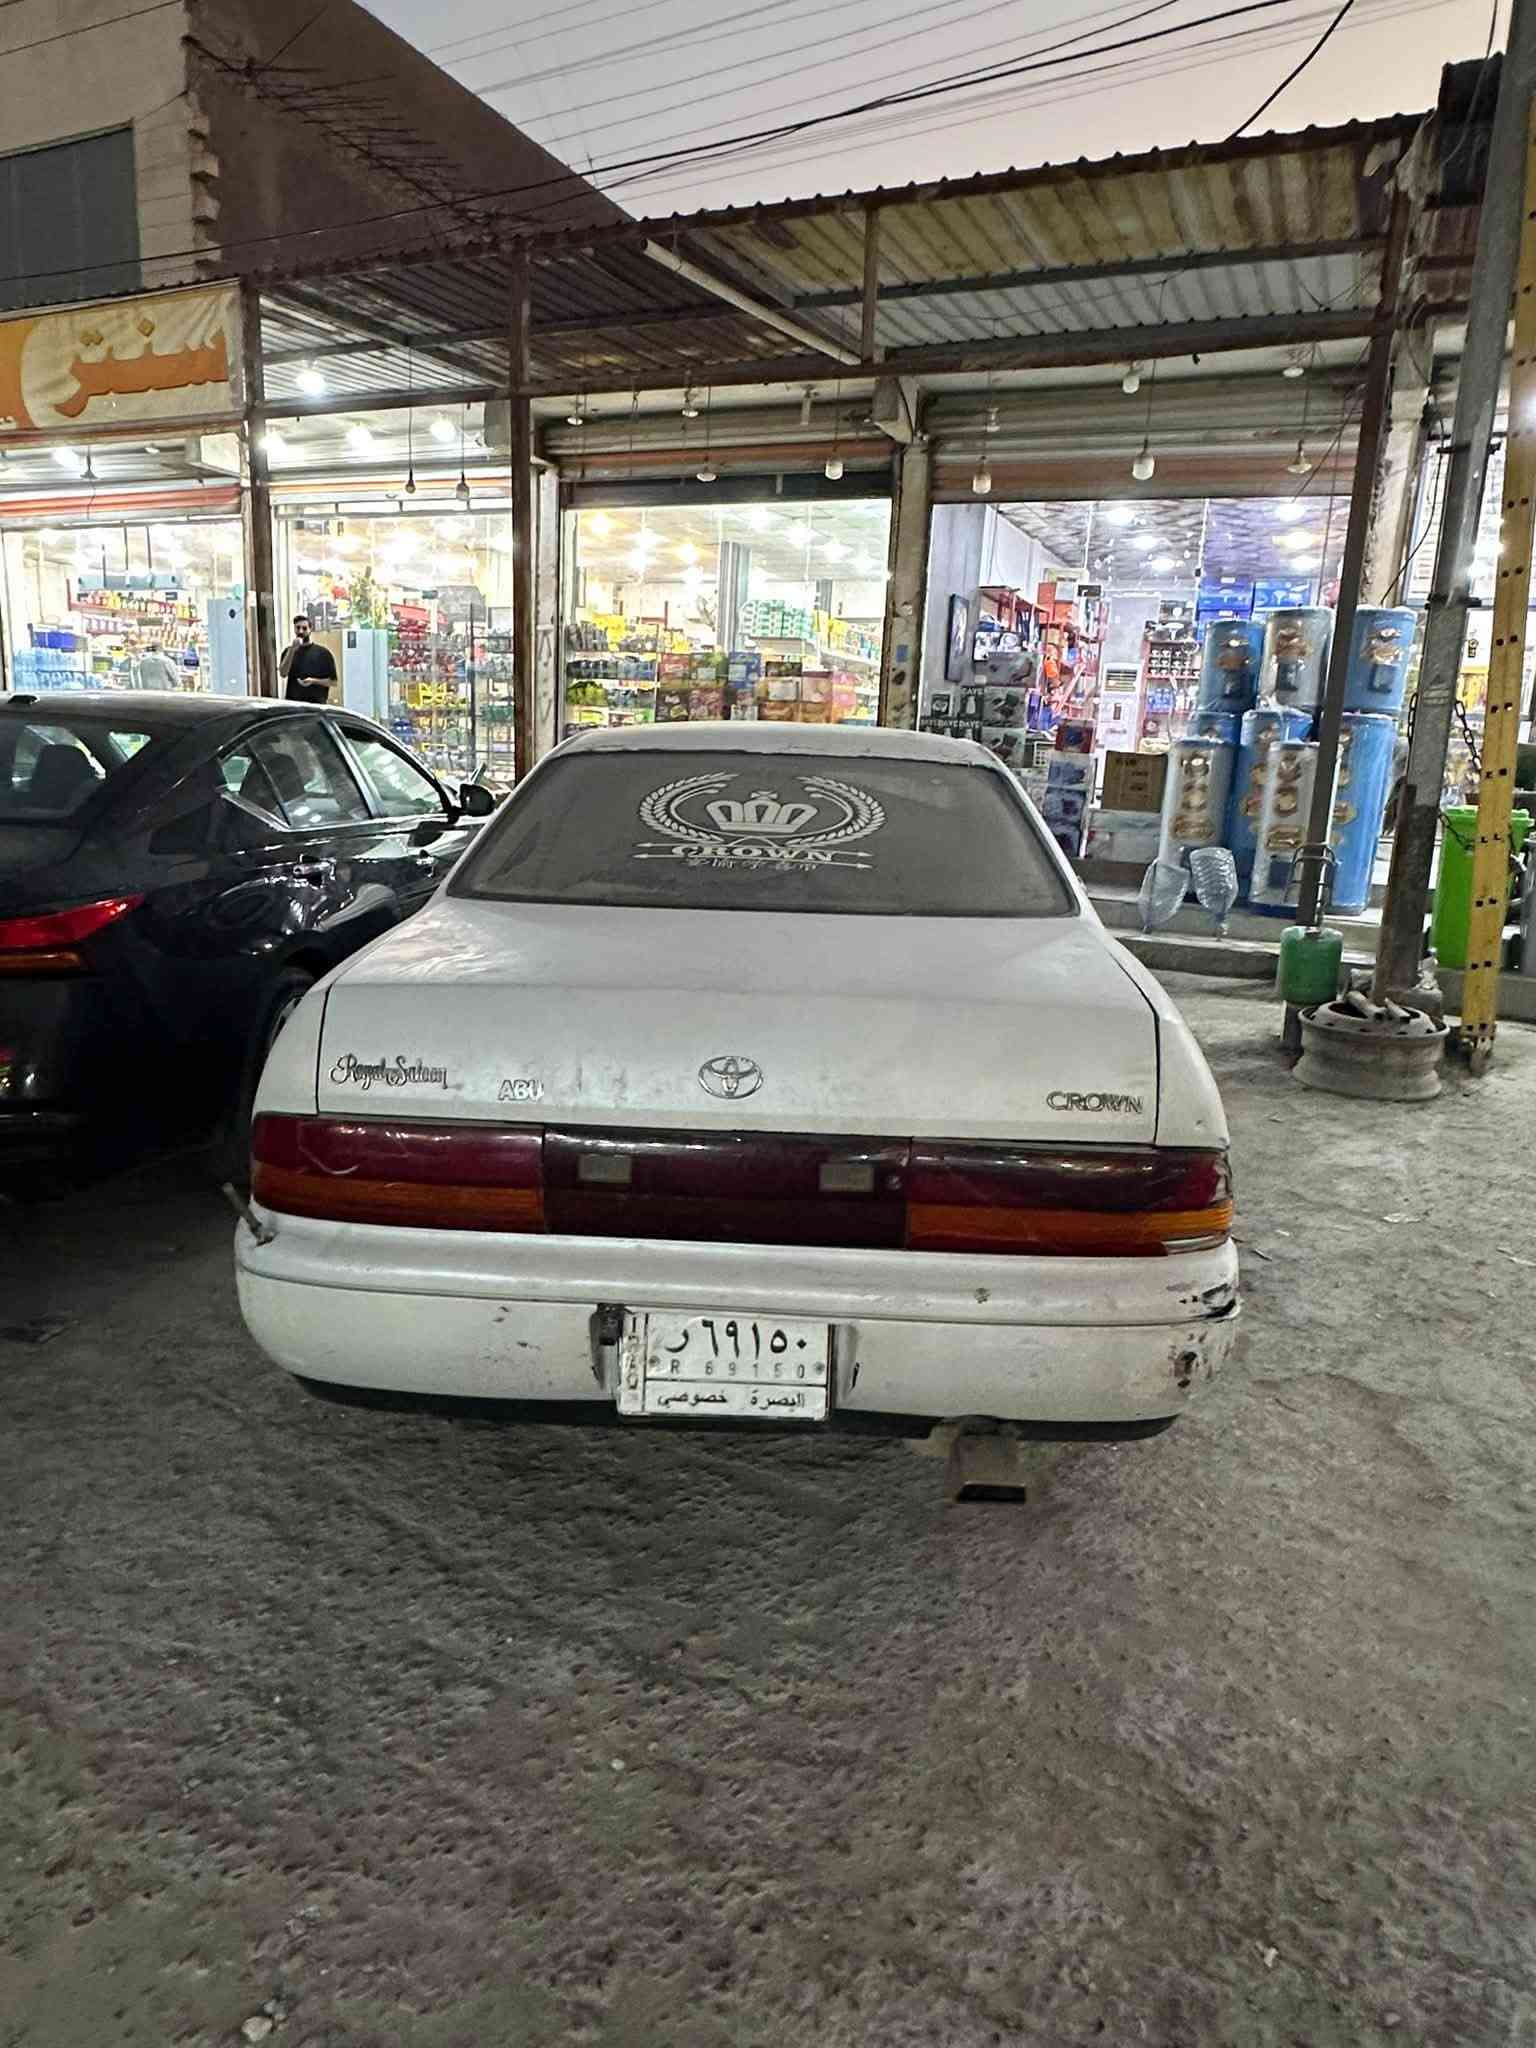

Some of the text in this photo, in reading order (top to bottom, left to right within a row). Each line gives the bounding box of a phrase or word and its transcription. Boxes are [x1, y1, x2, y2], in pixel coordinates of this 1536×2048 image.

[53, 317, 229, 418] سنتر
[671, 846, 835, 862] CROWN
[330, 1053, 448, 1090] Royal Saloon
[1046, 1090, 1144, 1114] CROWN
[656, 1388, 806, 1414] البصرة خصوصي
